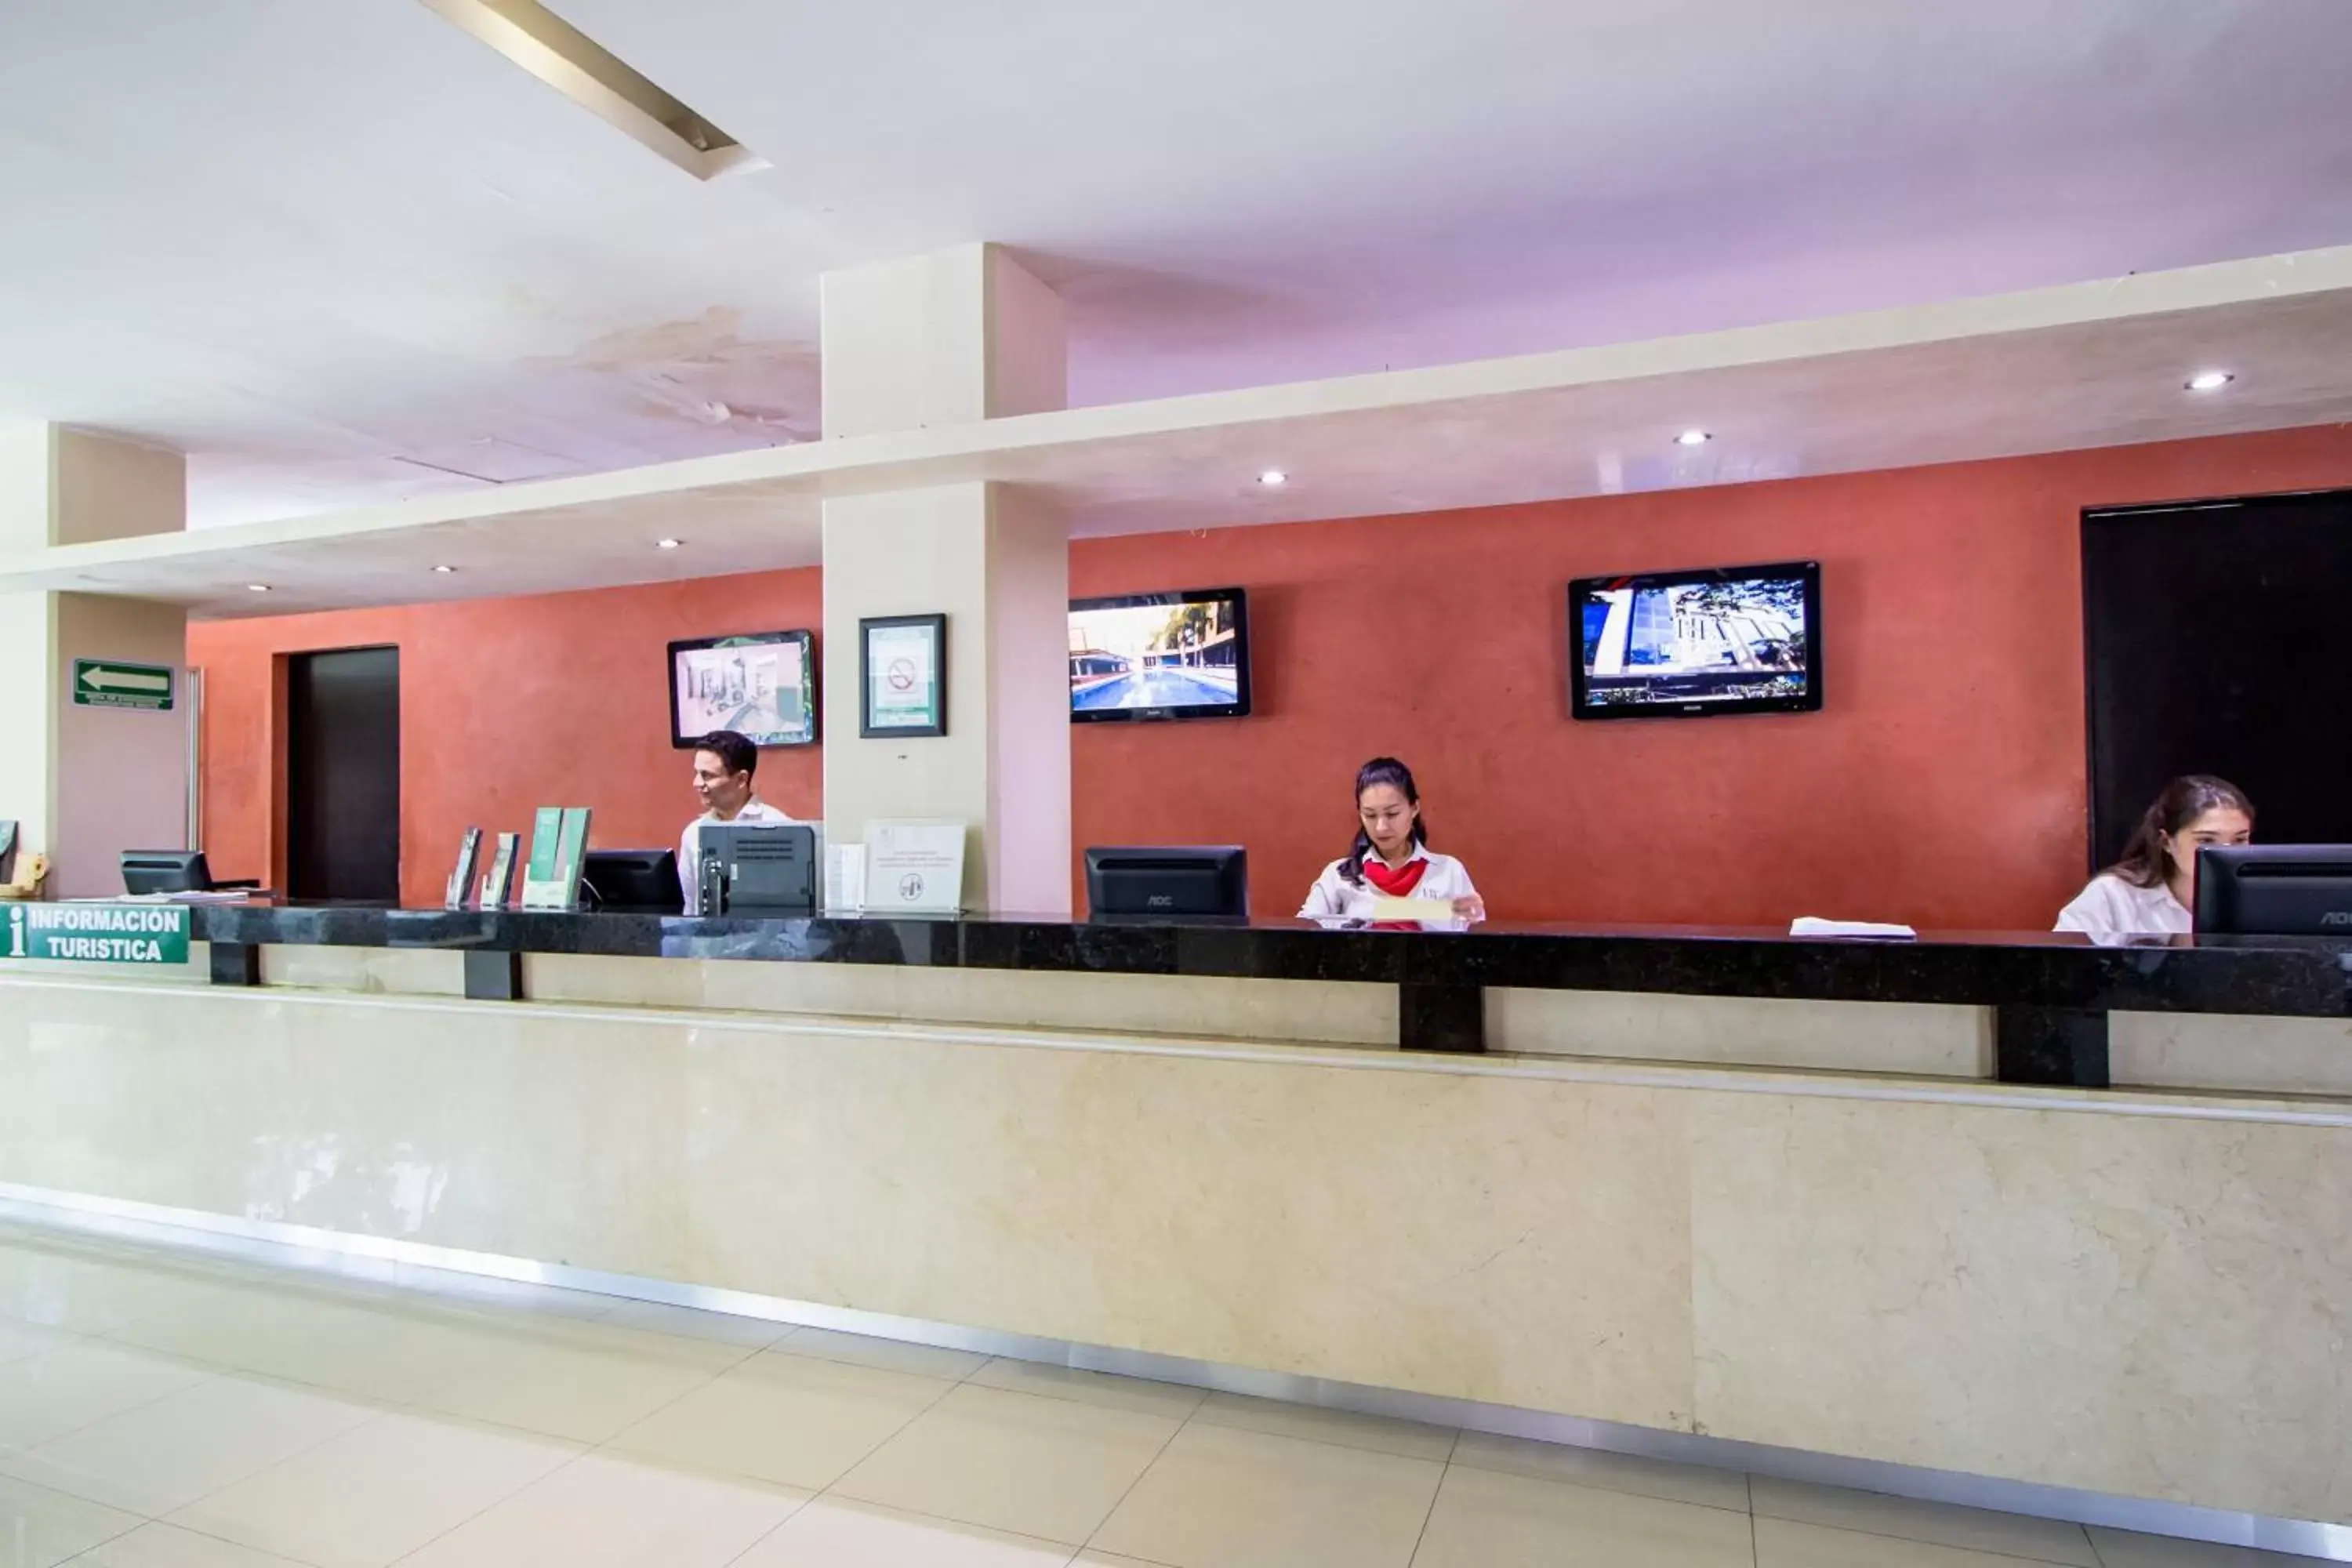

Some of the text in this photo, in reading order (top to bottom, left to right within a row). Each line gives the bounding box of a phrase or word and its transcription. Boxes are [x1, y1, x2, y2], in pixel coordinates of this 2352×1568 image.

[1147, 895, 1173, 907] AOC
[31, 907, 180, 932] INFORMACIÓN
[2320, 912, 2352, 925] AO
[47, 937, 162, 960] TURISTICA
